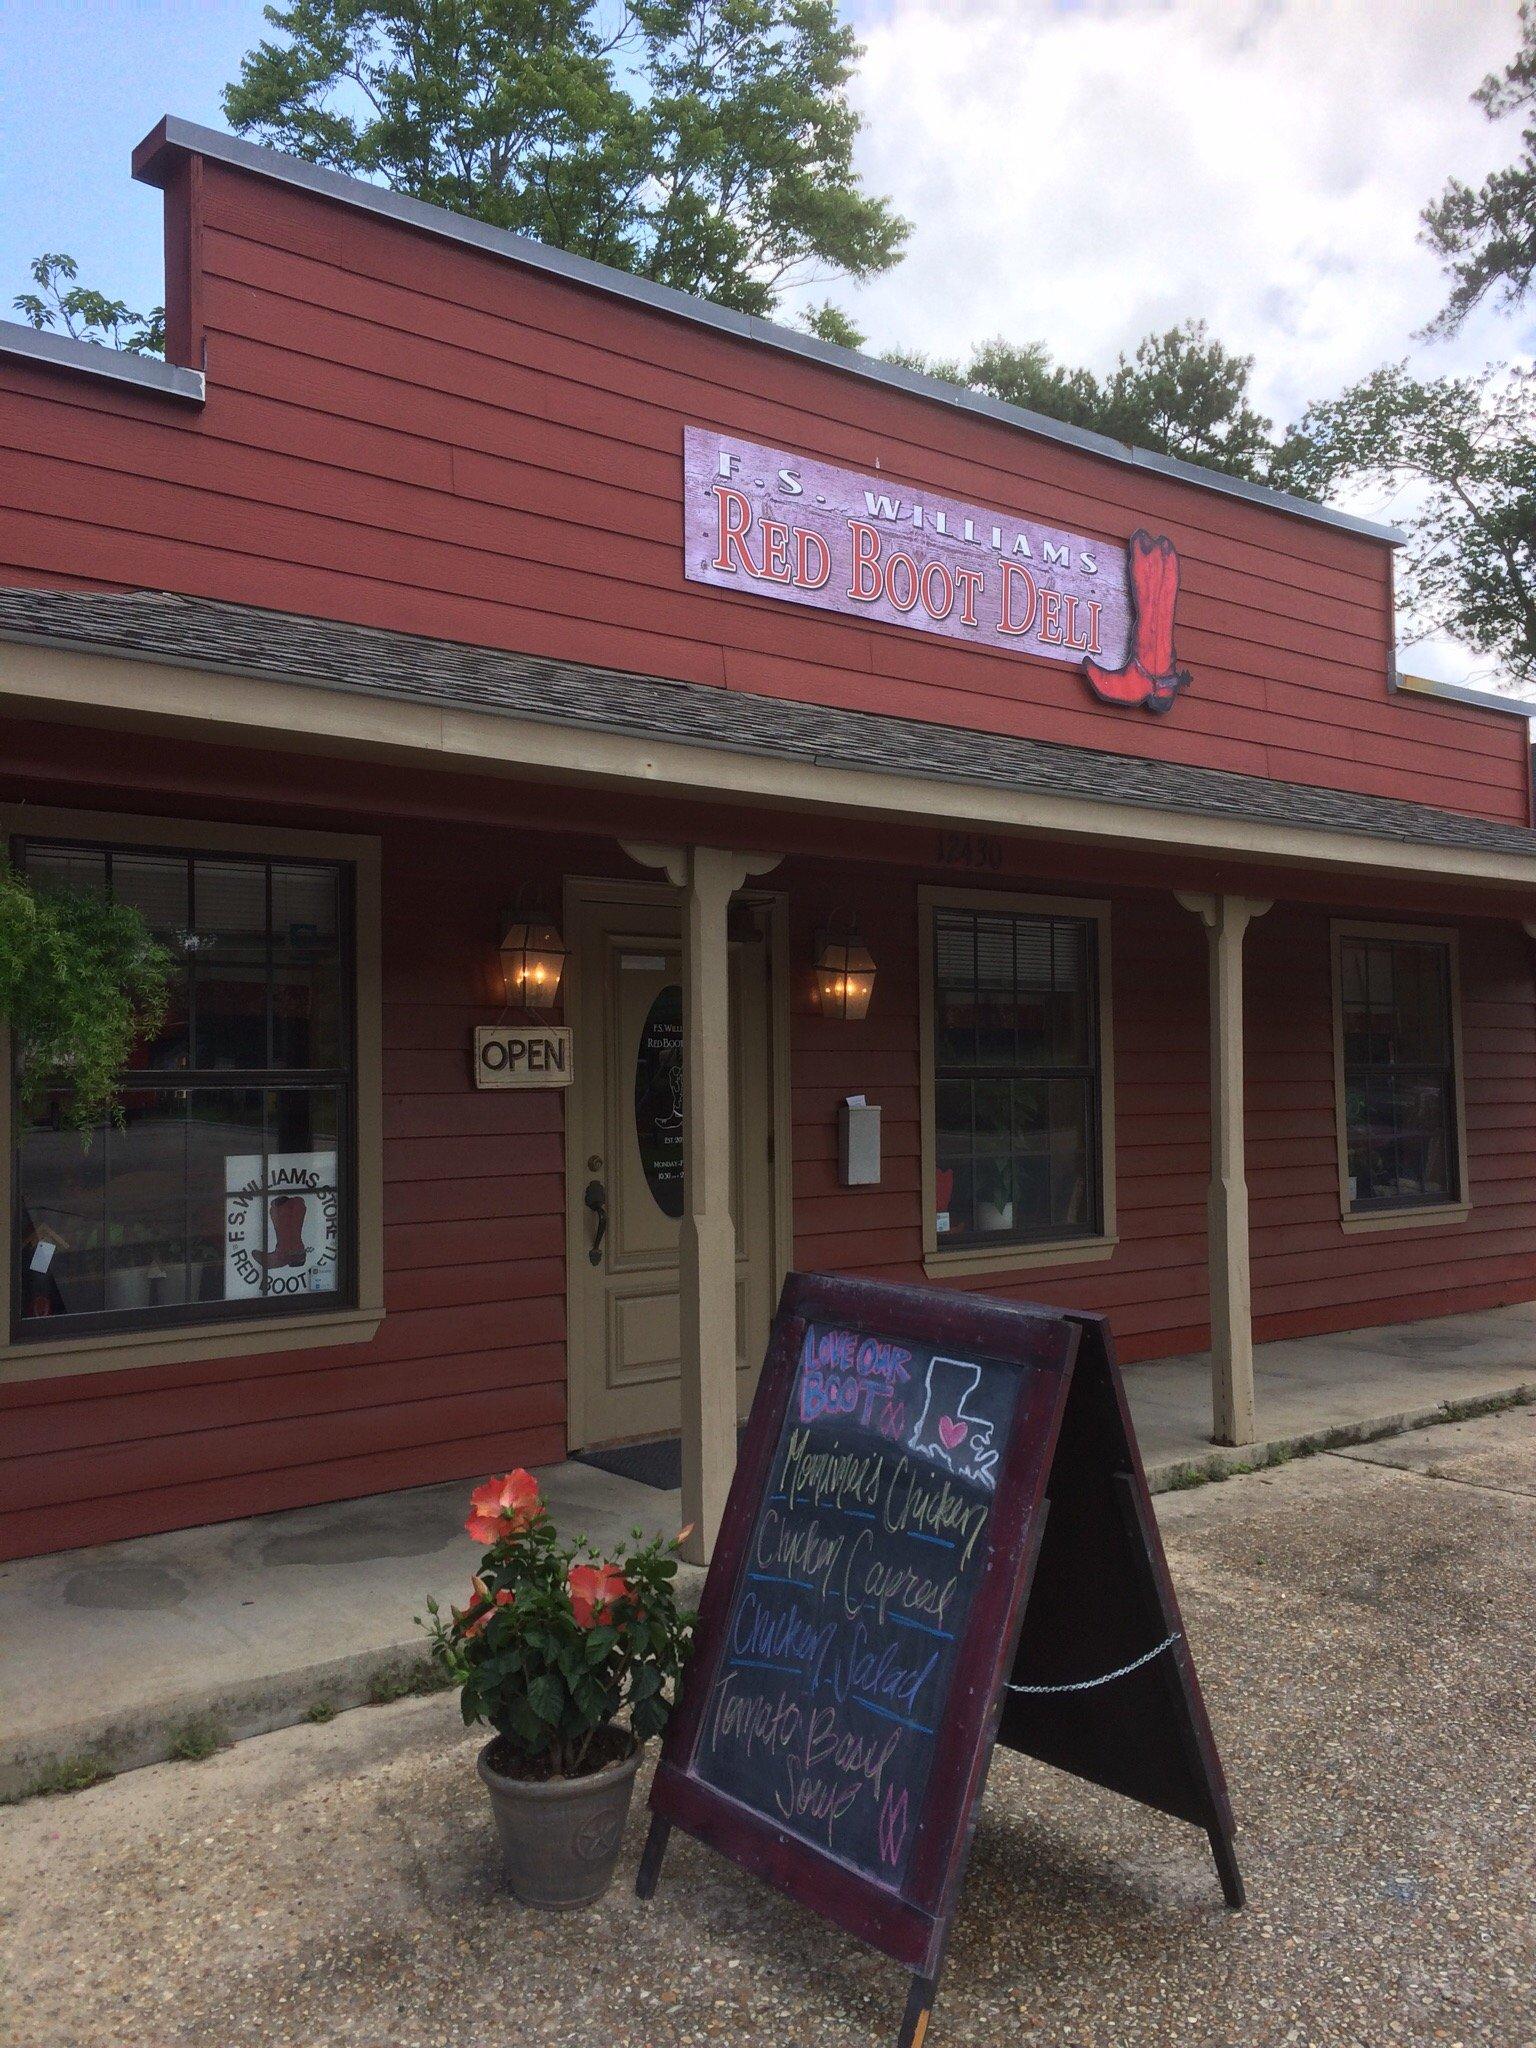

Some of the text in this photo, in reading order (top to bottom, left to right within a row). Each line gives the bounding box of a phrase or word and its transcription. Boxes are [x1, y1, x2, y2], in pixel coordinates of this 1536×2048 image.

[711, 484, 1103, 654] RED BOOT DELI
[864, 490, 1099, 574] WILLIAMS
[482, 1038, 566, 1071] OPEN
[231, 1249, 260, 1284] RED
[259, 1272, 309, 1294] BOOT
[801, 1371, 894, 1425] BOOT
[803, 1324, 912, 1386] LOVE OUR
[758, 1509, 845, 1602] Chicken
[884, 1456, 988, 1571] Chicken
[734, 1593, 939, 1715] Chicken Salad
[712, 1670, 902, 1802] Tomato Basil
[775, 1754, 862, 1847] Soup
